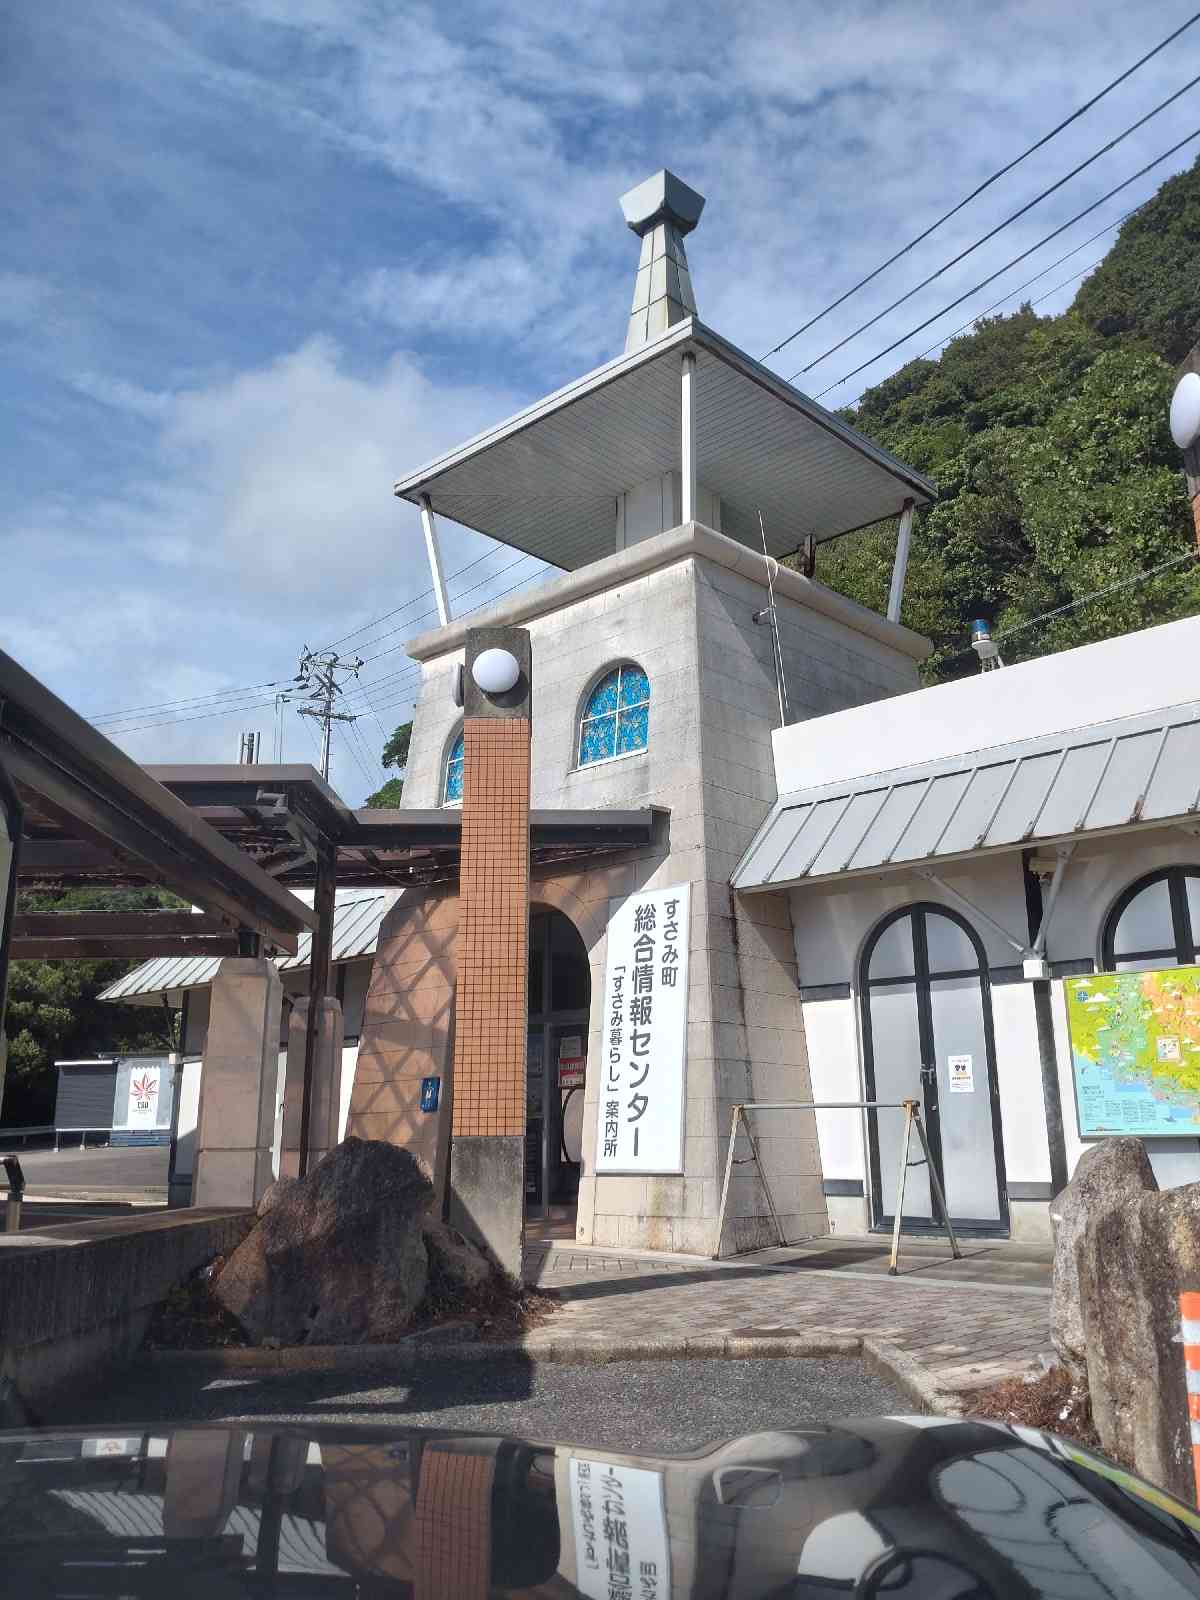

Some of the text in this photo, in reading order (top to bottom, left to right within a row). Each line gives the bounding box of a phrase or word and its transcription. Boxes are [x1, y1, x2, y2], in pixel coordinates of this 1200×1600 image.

[661, 898, 680, 987] すさみ町
[627, 903, 656, 1157] 総合情報センター
